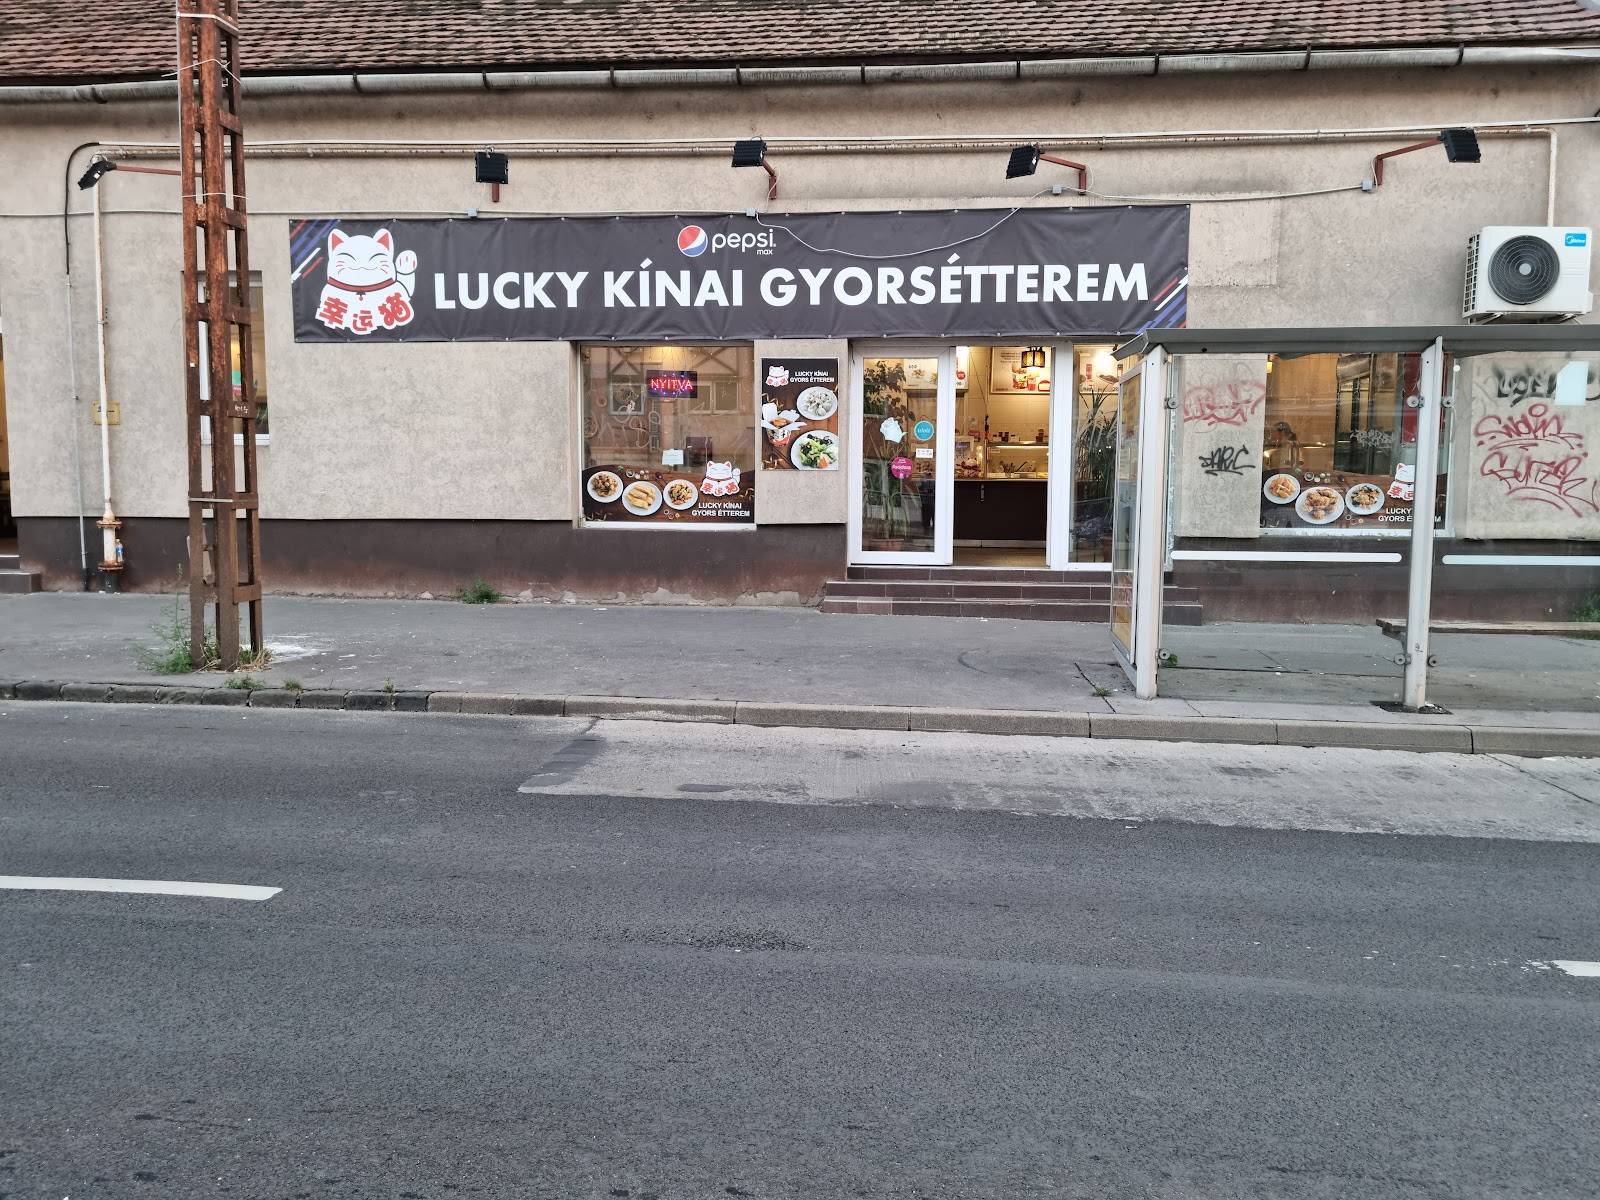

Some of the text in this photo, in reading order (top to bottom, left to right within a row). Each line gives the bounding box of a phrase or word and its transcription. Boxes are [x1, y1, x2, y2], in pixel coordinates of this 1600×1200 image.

[434, 252, 1149, 310] LUCKY KÍNAI GYORSÉTTEREM
[809, 375, 835, 383] ÉTTEREM
[650, 378, 693, 390] NYITVA
[723, 501, 742, 509] KÍNAI
[717, 508, 751, 517] ÉTTEREM
